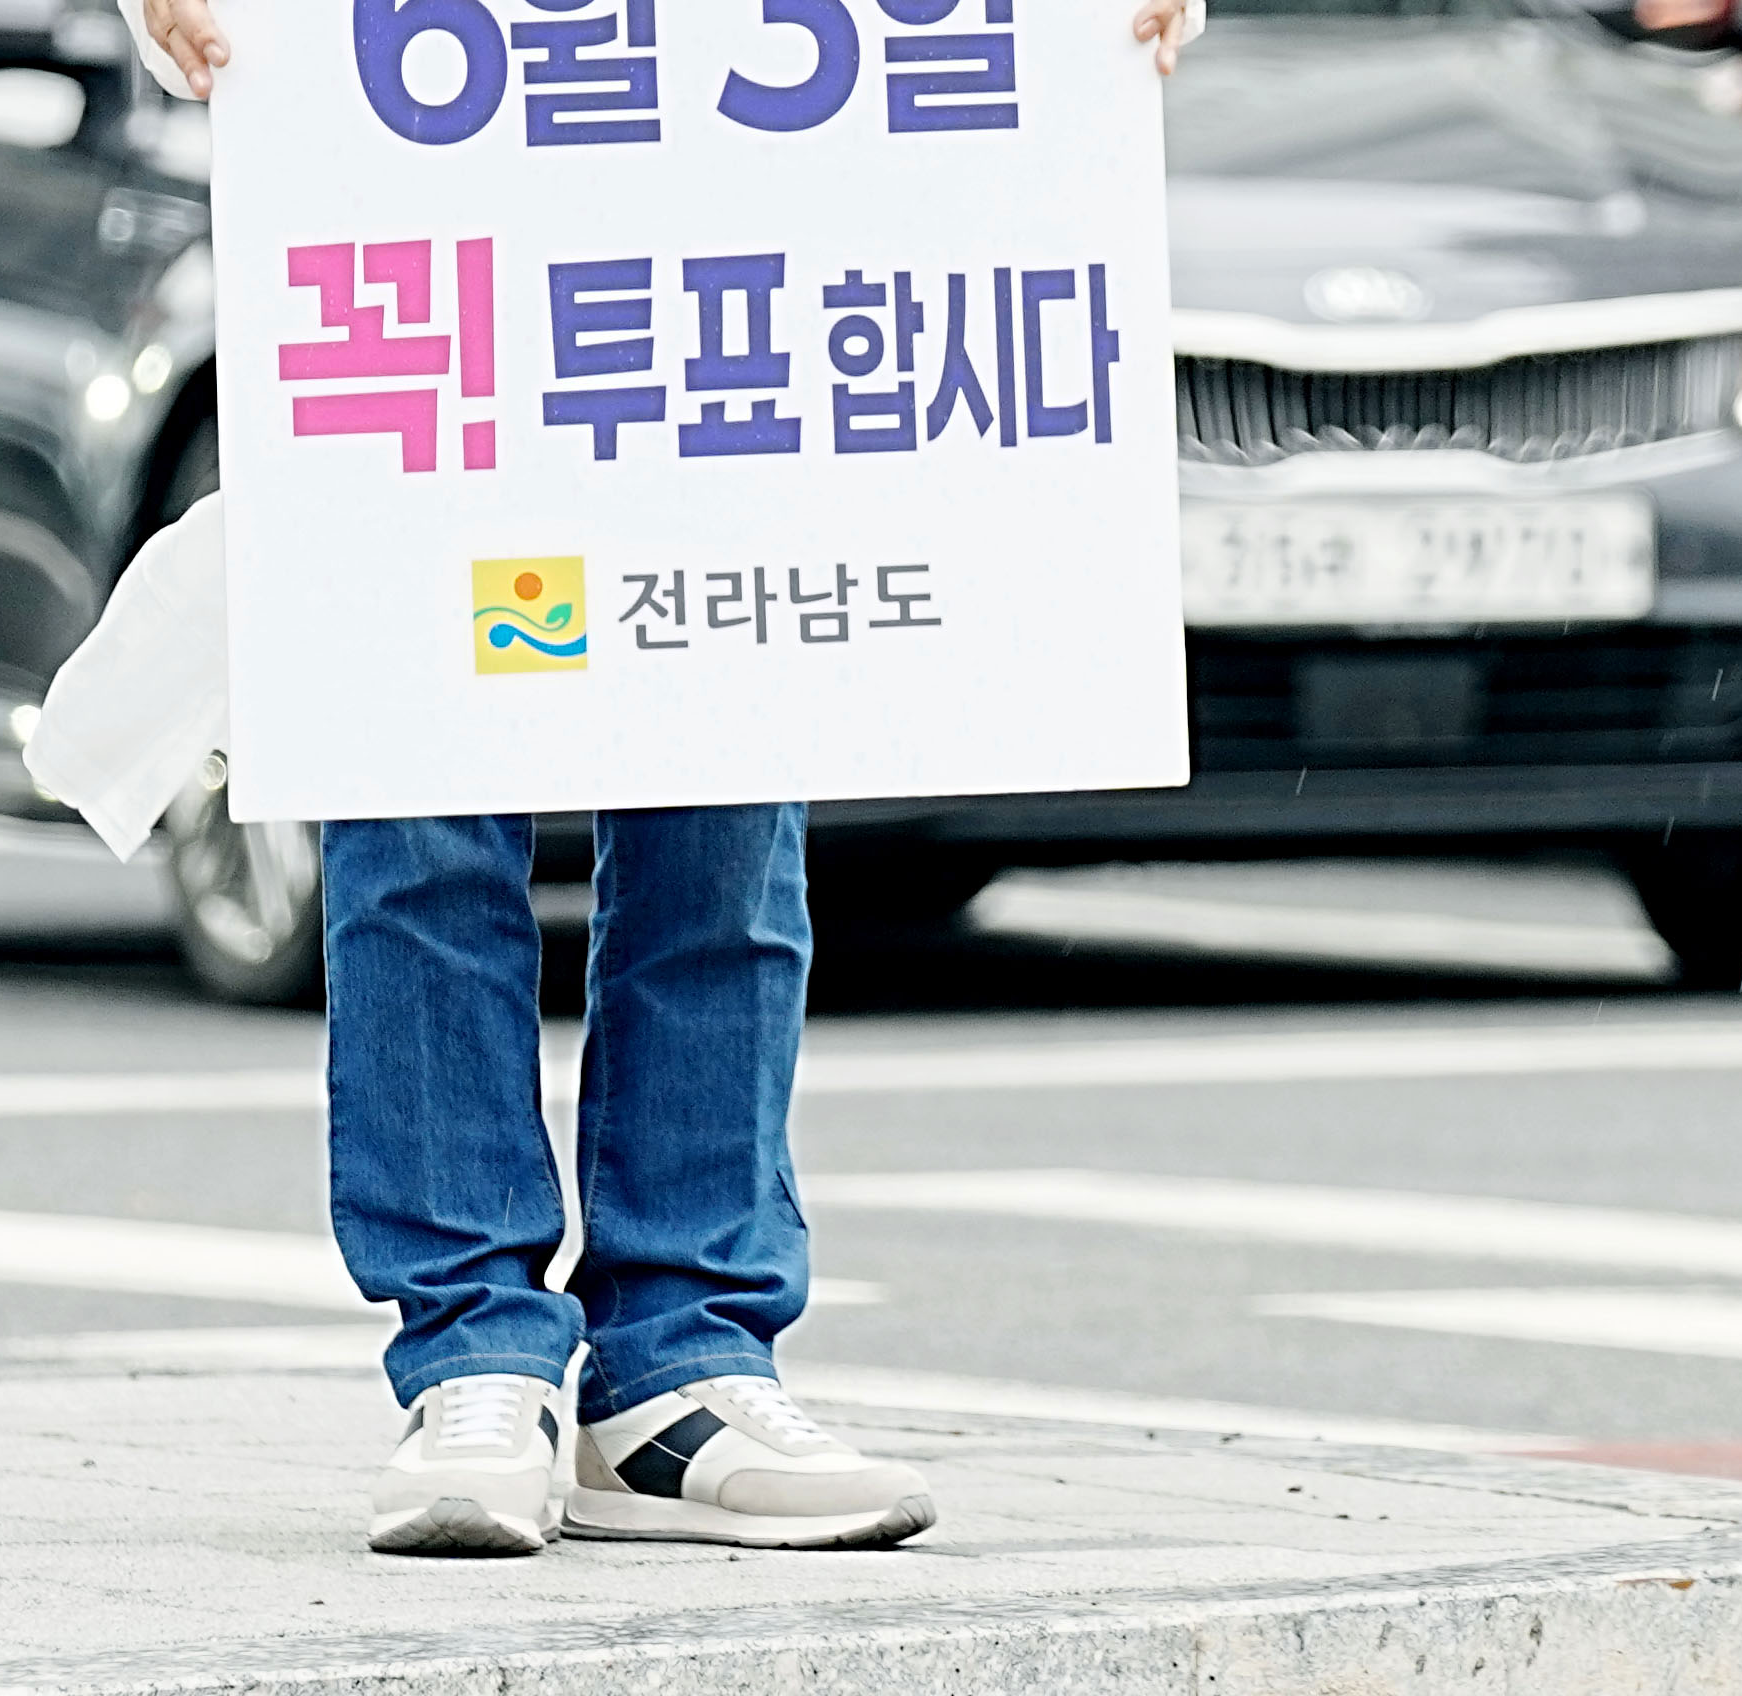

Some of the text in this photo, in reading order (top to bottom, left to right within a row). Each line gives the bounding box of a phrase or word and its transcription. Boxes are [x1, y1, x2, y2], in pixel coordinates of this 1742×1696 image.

[278, 237, 1120, 473] 꼭! 투표 합시다
[619, 564, 941, 649] 전라남도
